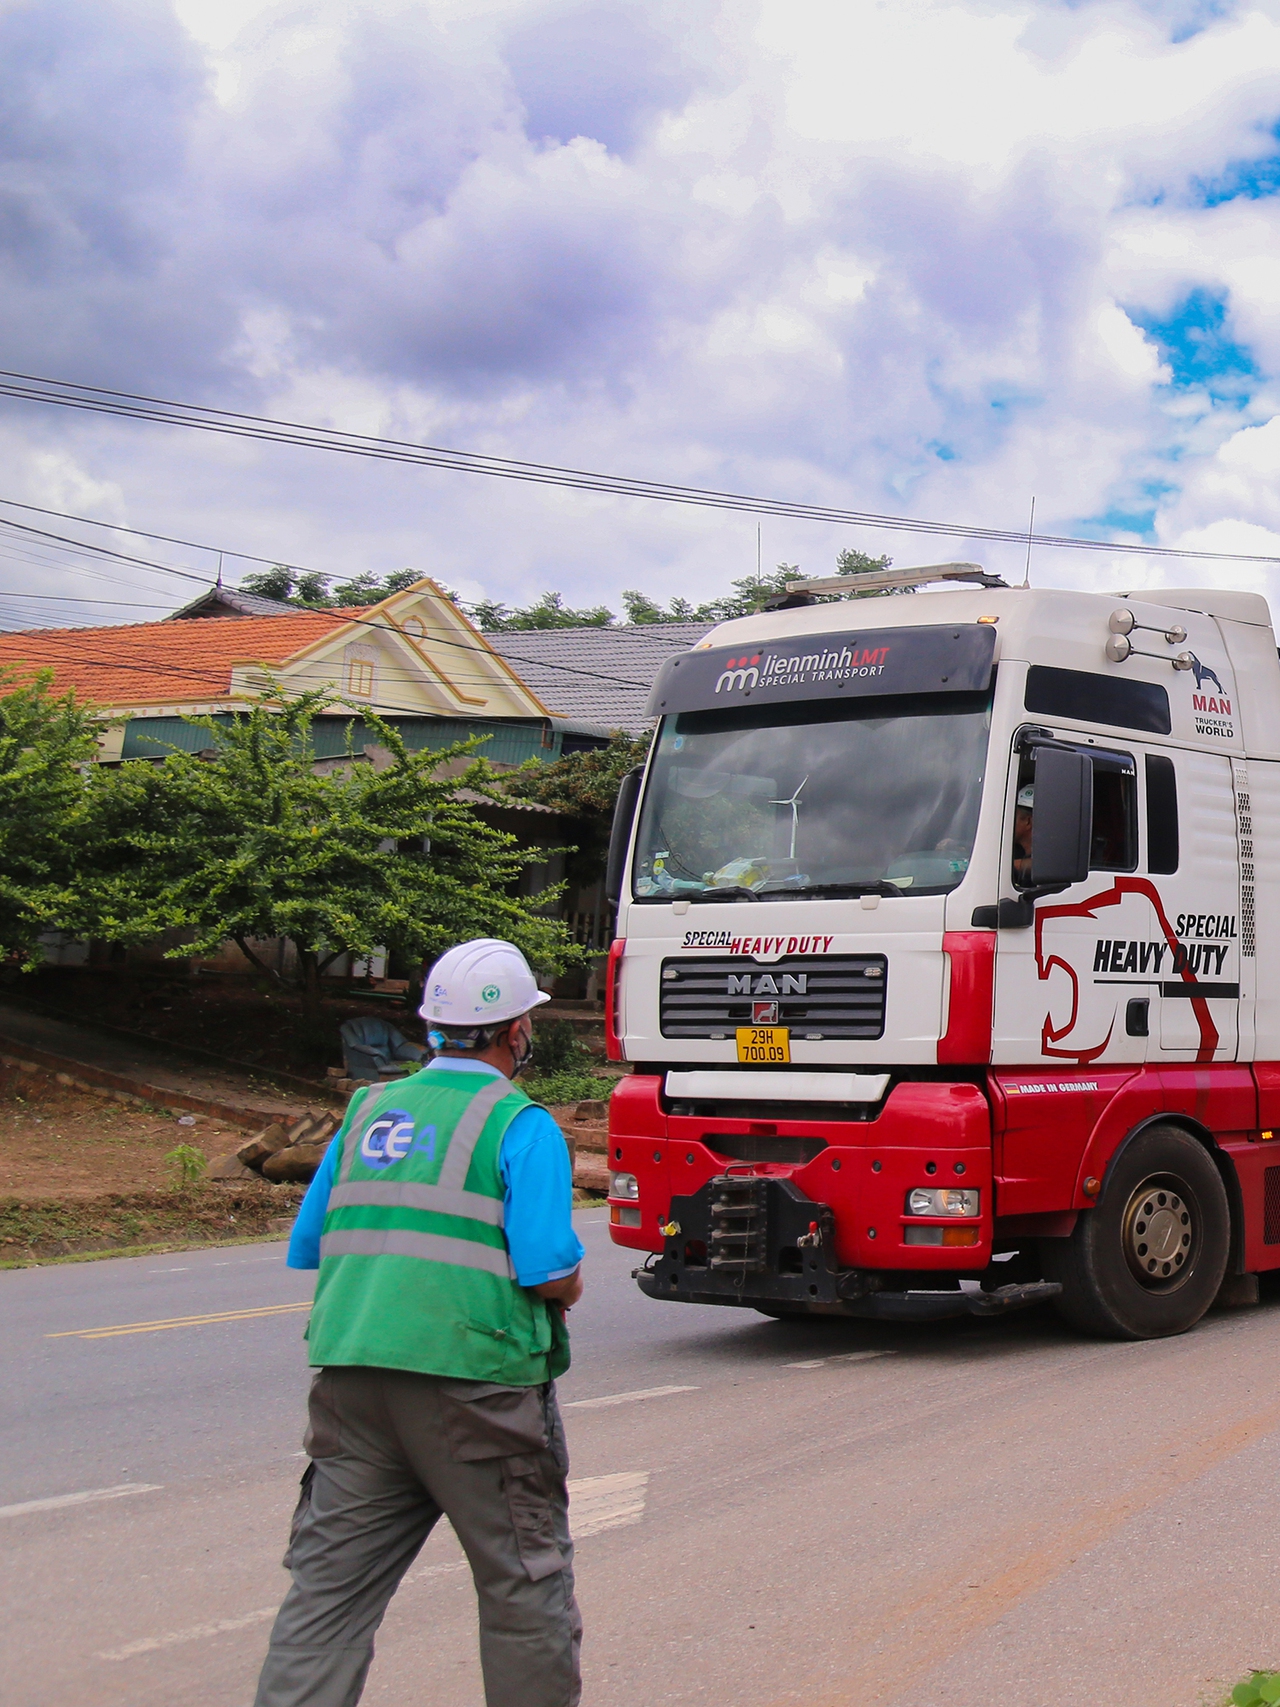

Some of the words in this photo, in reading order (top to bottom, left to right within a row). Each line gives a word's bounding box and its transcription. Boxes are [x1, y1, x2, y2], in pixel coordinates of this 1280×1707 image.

[759, 674, 805, 688] SPECIAL
[811, 665, 885, 682] TRANSPORT
[1192, 694, 1232, 716] MAN
[1195, 717, 1233, 728] TRUCKER'S
[1195, 725, 1234, 738] WORLD
[1175, 913, 1238, 939] SPECIAL
[683, 931, 733, 946] SPECIAL
[729, 936, 786, 955] HEAVY
[786, 936, 834, 954] DUTY
[1093, 939, 1170, 974] HEAVY
[1171, 942, 1229, 976] DUTY
[727, 973, 808, 996] MAN
[751, 1029, 774, 1044] 29H
[742, 1046, 785, 1061] 700.09
[1020, 1084, 1046, 1094] MADE
[1047, 1083, 1058, 1093] IN
[1058, 1081, 1099, 1093] GERMANY
[361, 1120, 437, 1162] CEA
